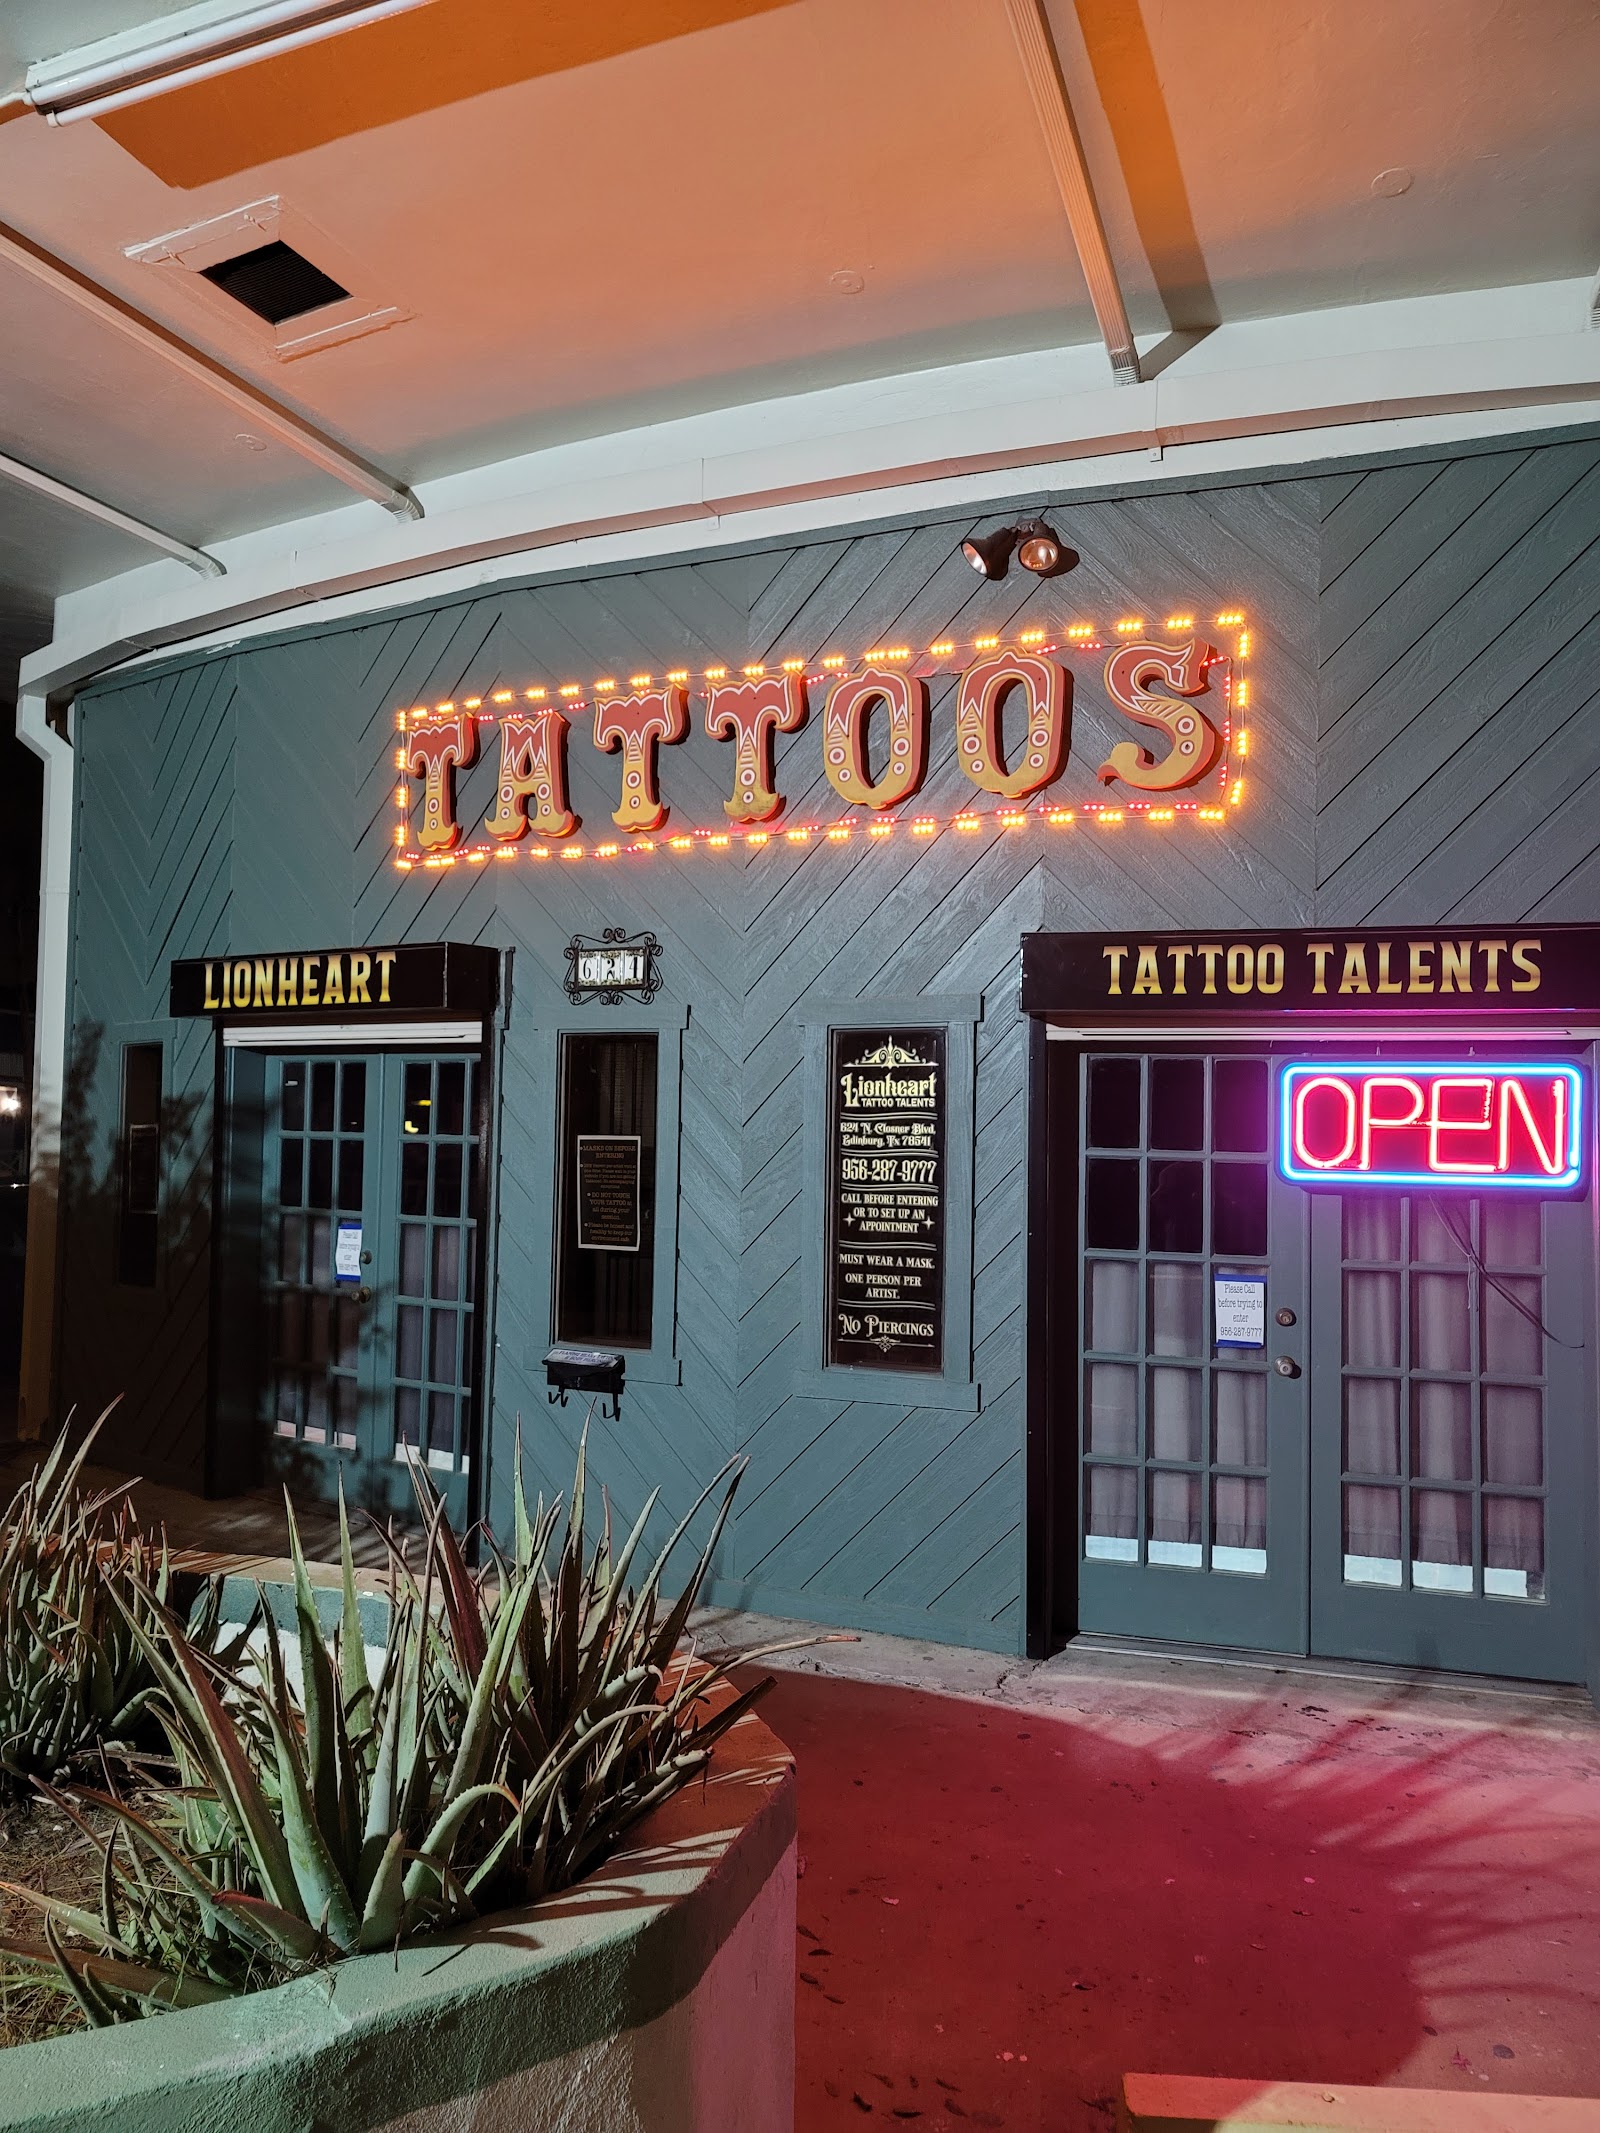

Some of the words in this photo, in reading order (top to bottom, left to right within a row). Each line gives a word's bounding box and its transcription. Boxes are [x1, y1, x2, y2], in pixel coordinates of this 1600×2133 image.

[405, 638, 1226, 851] TATTOOS
[583, 956, 640, 980] 624
[1102, 943, 1285, 995] TATTOO
[1306, 939, 1542, 995] TALENTS
[203, 950, 397, 1010] LIONHEART
[840, 1072, 937, 1107] Lionheart
[861, 1098, 894, 1108] TATTOO
[895, 1098, 936, 1108] TALENTS
[840, 1122, 859, 1133] 624
[874, 1122, 910, 1135] Closner
[1294, 1075, 1566, 1176] OPEN
[886, 1135, 900, 1147] Tx
[902, 1135, 931, 1147] 78541
[842, 1158, 937, 1183] 956-287-9777
[841, 1193, 862, 1204] CALL
[863, 1193, 895, 1205] BEFORE
[896, 1195, 939, 1207] ENTERING
[853, 1207, 865, 1218] OR
[868, 1207, 879, 1218] TO
[880, 1208, 896, 1219] SET
[898, 1208, 911, 1219] UP
[912, 1209, 925, 1220] AN
[859, 1221, 920, 1233] APPOINTMENT
[839, 1253, 864, 1265] MUST
[866, 1254, 894, 1266] WEAR
[896, 1256, 904, 1267] A
[905, 1257, 936, 1269] MASK.
[845, 1272, 863, 1283] ONE
[865, 1273, 901, 1285] PERSON
[903, 1275, 922, 1287] PER
[865, 1287, 901, 1299] ARTIST.
[1224, 1284, 1243, 1294] Please
[1244, 1284, 1256, 1294] Call
[1217, 1298, 1236, 1308] before
[1237, 1299, 1256, 1310] trying
[1257, 1300, 1263, 1308] to
[1232, 1314, 1249, 1323] enter
[1220, 1326, 1262, 1337] 956-287-9777
